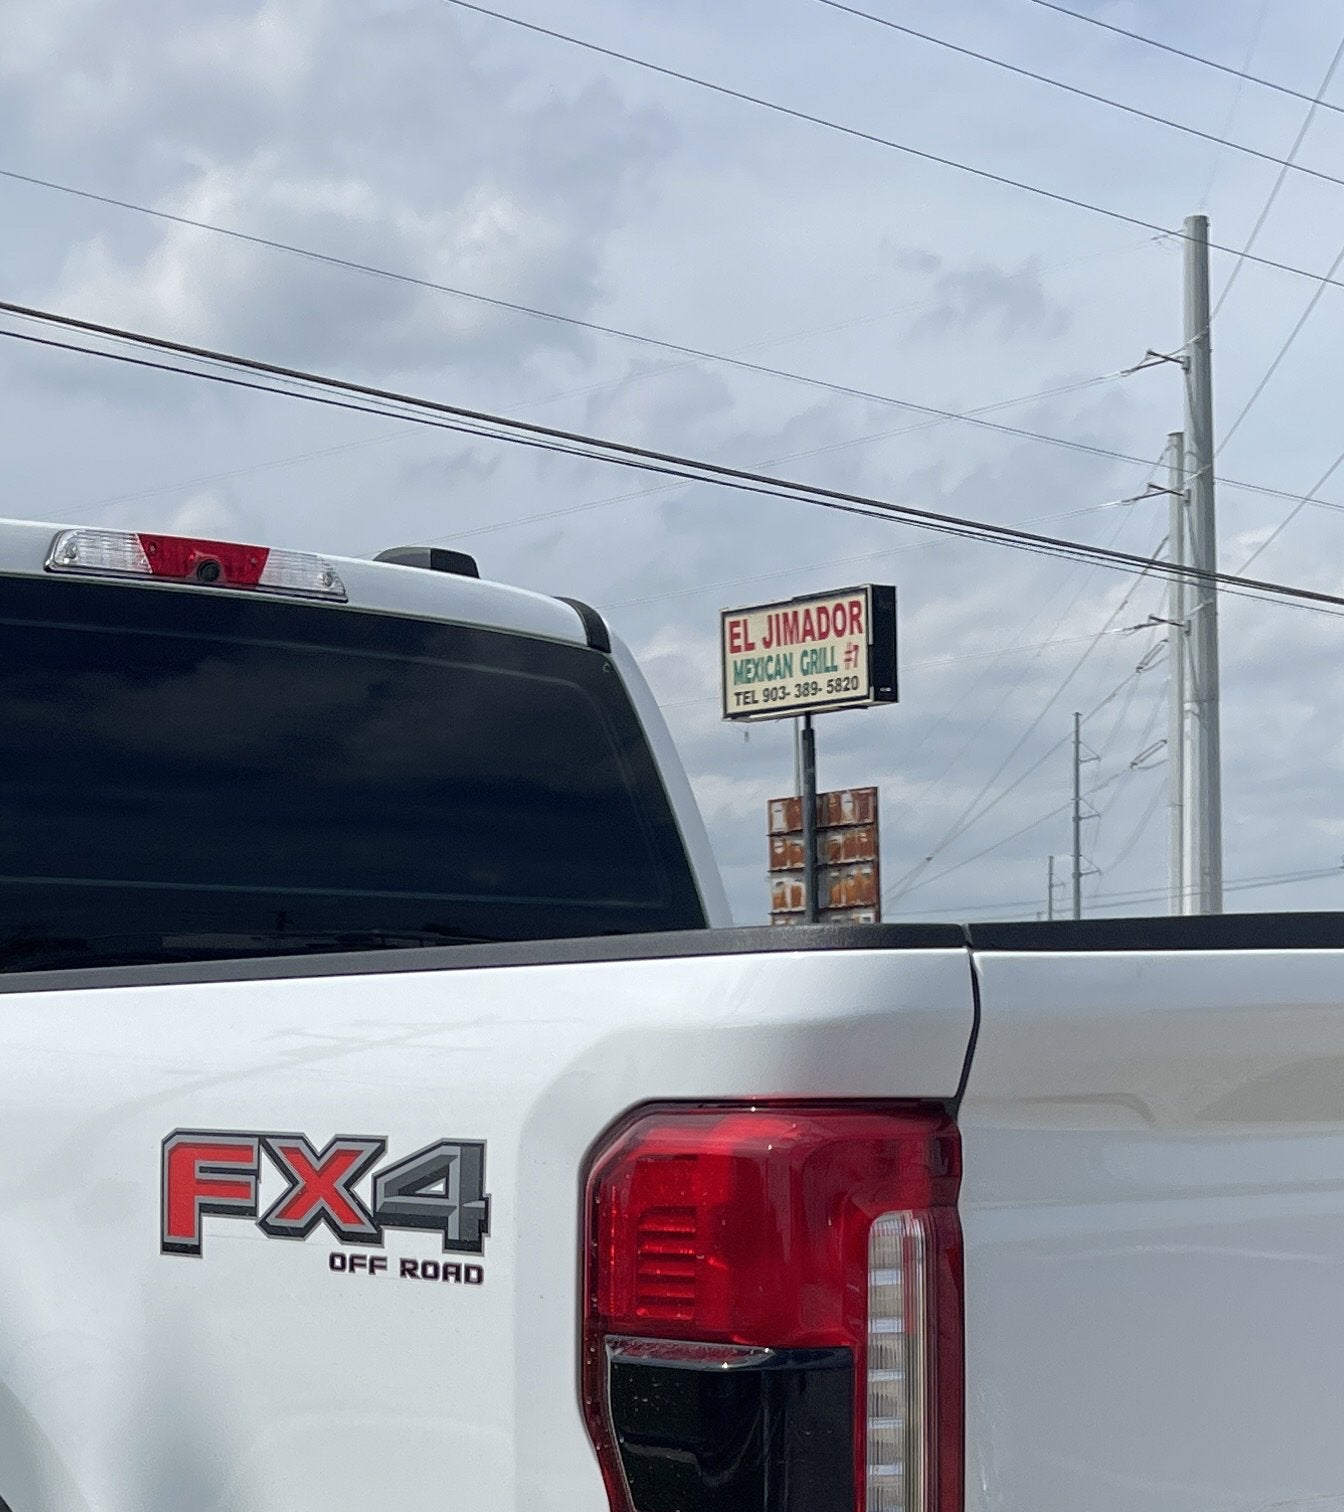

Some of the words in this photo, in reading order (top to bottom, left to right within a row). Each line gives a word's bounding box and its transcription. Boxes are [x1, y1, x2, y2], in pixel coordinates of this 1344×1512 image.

[729, 619, 755, 654] EL
[762, 600, 863, 649] JIMADOR
[733, 652, 793, 685] MEXICAN
[800, 646, 838, 676] GRILL
[734, 690, 758, 706] TEL
[160, 1128, 491, 1258] FX4
[329, 1252, 387, 1276] OFF
[399, 1257, 484, 1285] ROAD
